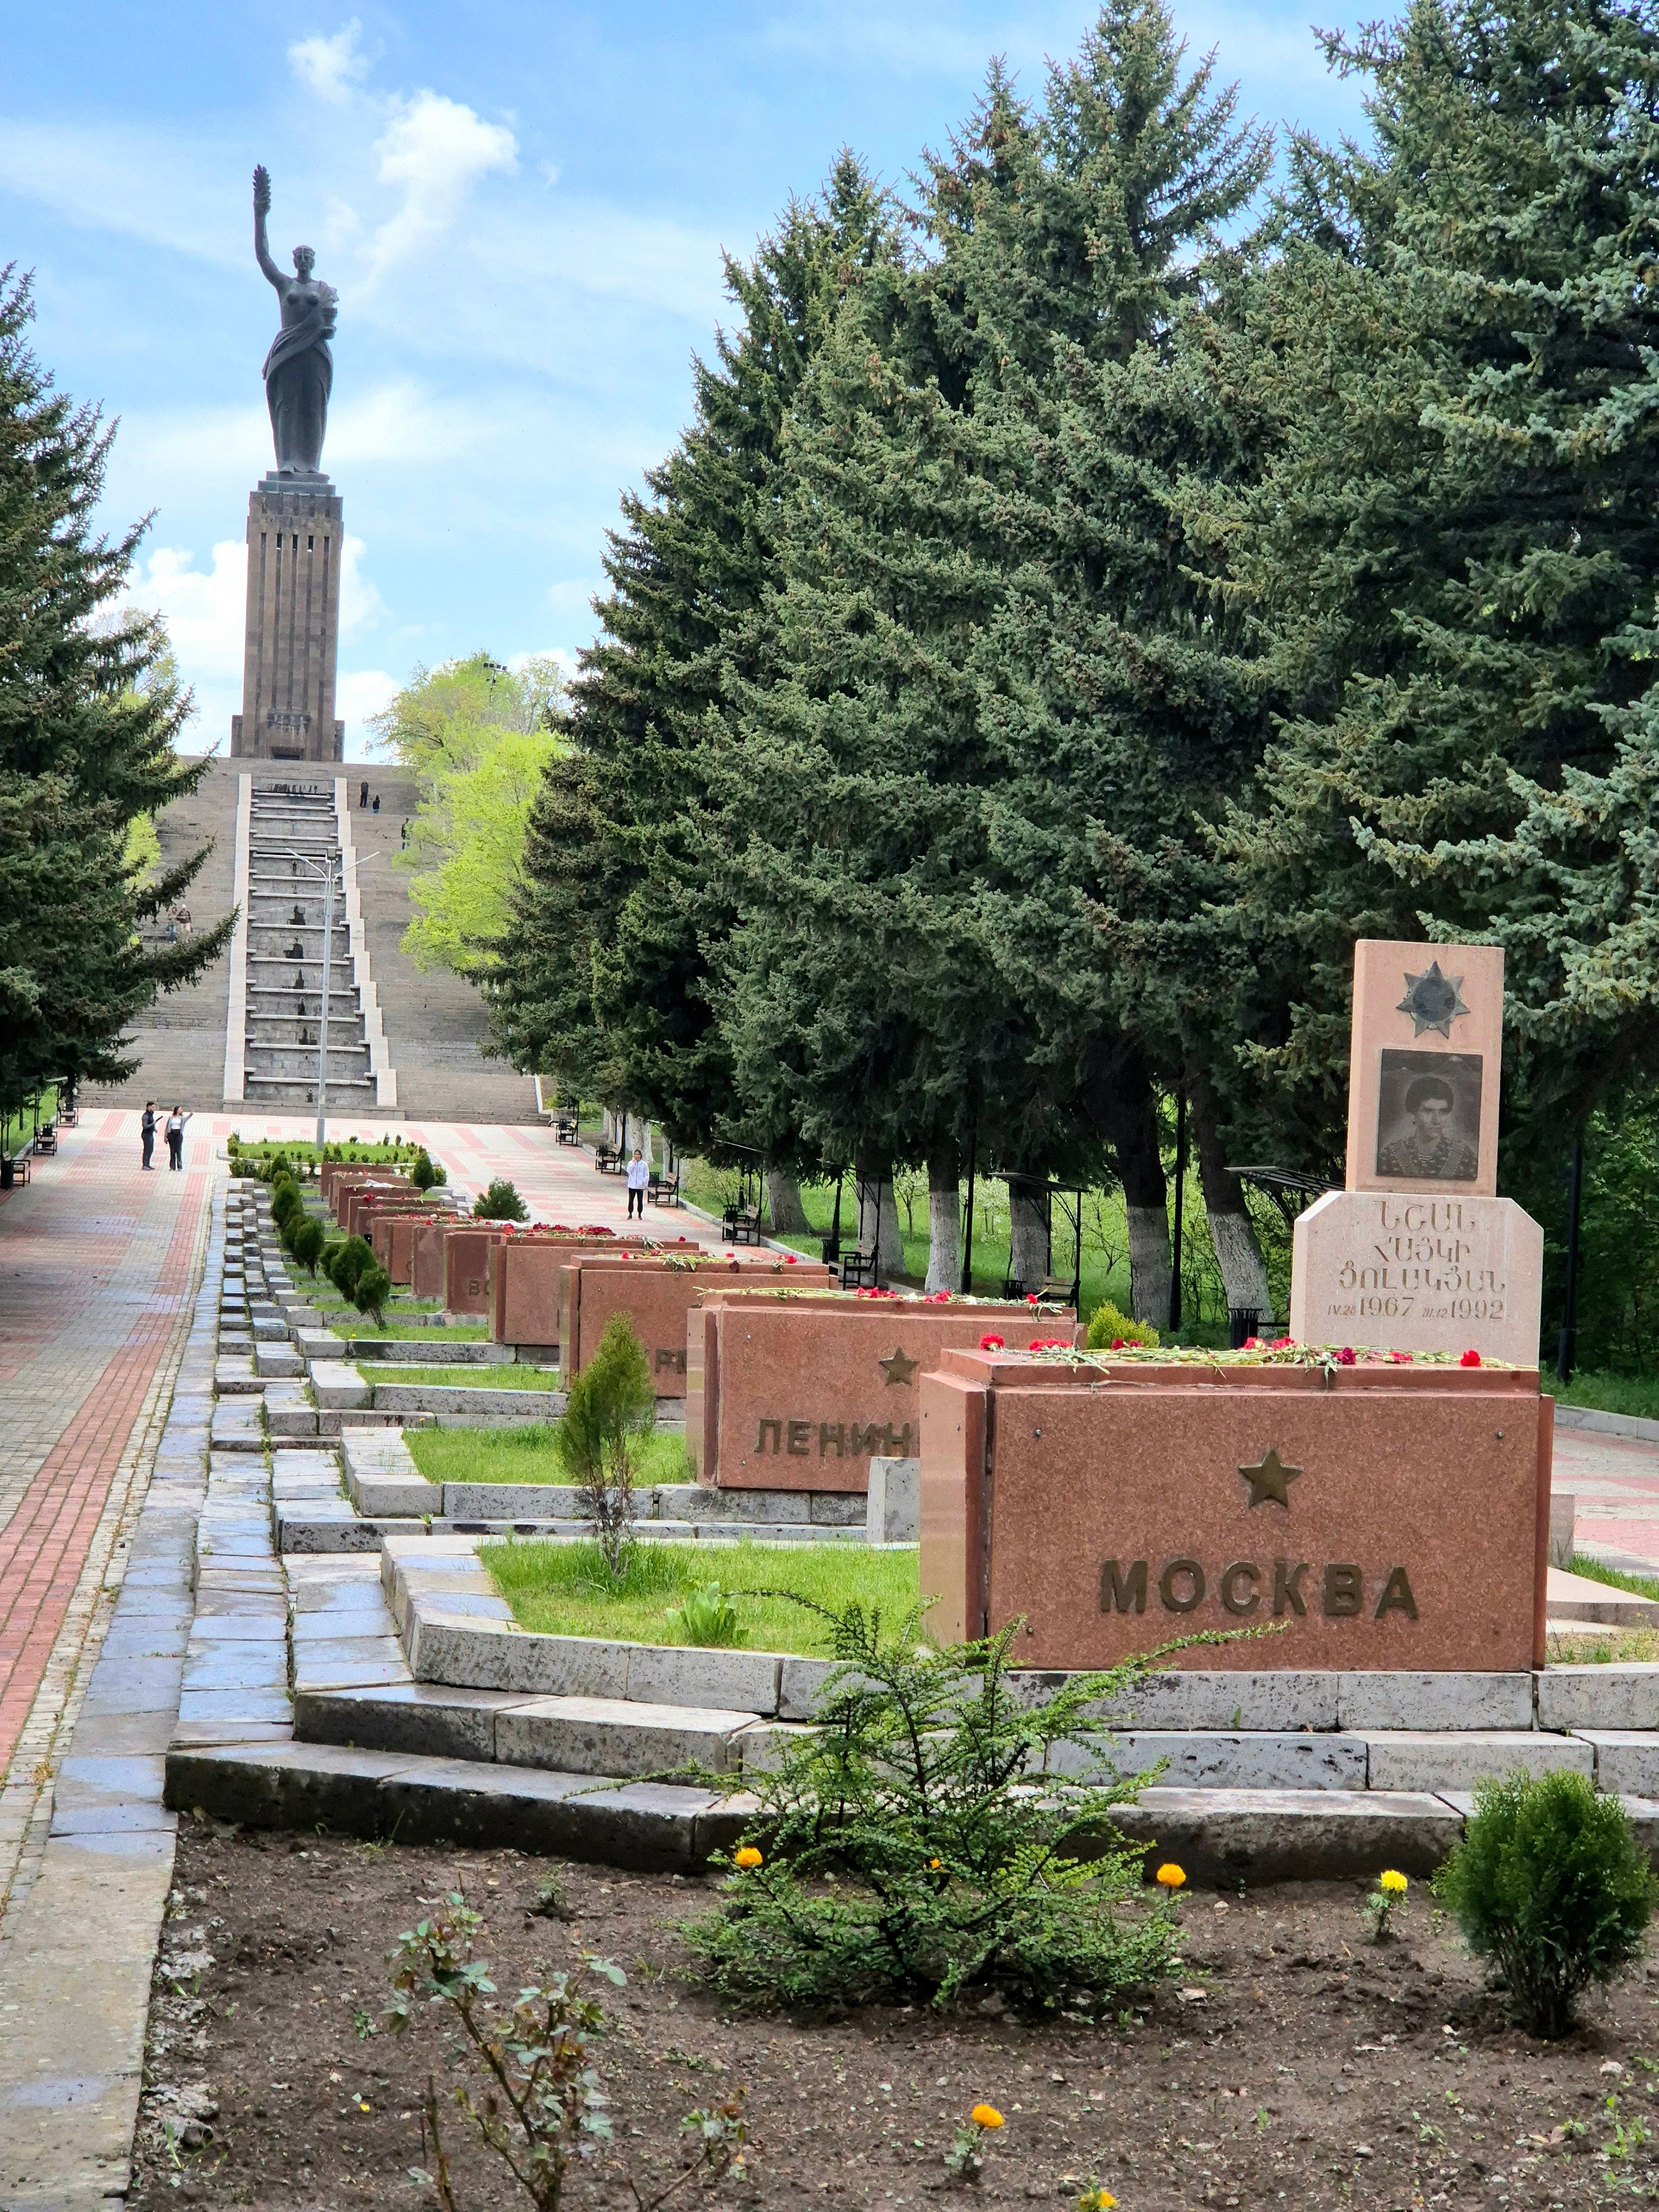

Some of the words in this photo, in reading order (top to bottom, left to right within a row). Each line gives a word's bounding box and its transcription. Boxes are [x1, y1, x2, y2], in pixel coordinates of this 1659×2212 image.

[1373, 1200, 1476, 1232] ՆՇԱՆ
[1374, 1236, 1471, 1263] ՀԱՅԿԻ
[1359, 1296, 1415, 1318] 1967
[1451, 1298, 1504, 1320] 1992
[1100, 1558, 1420, 1620] МОСКВА
